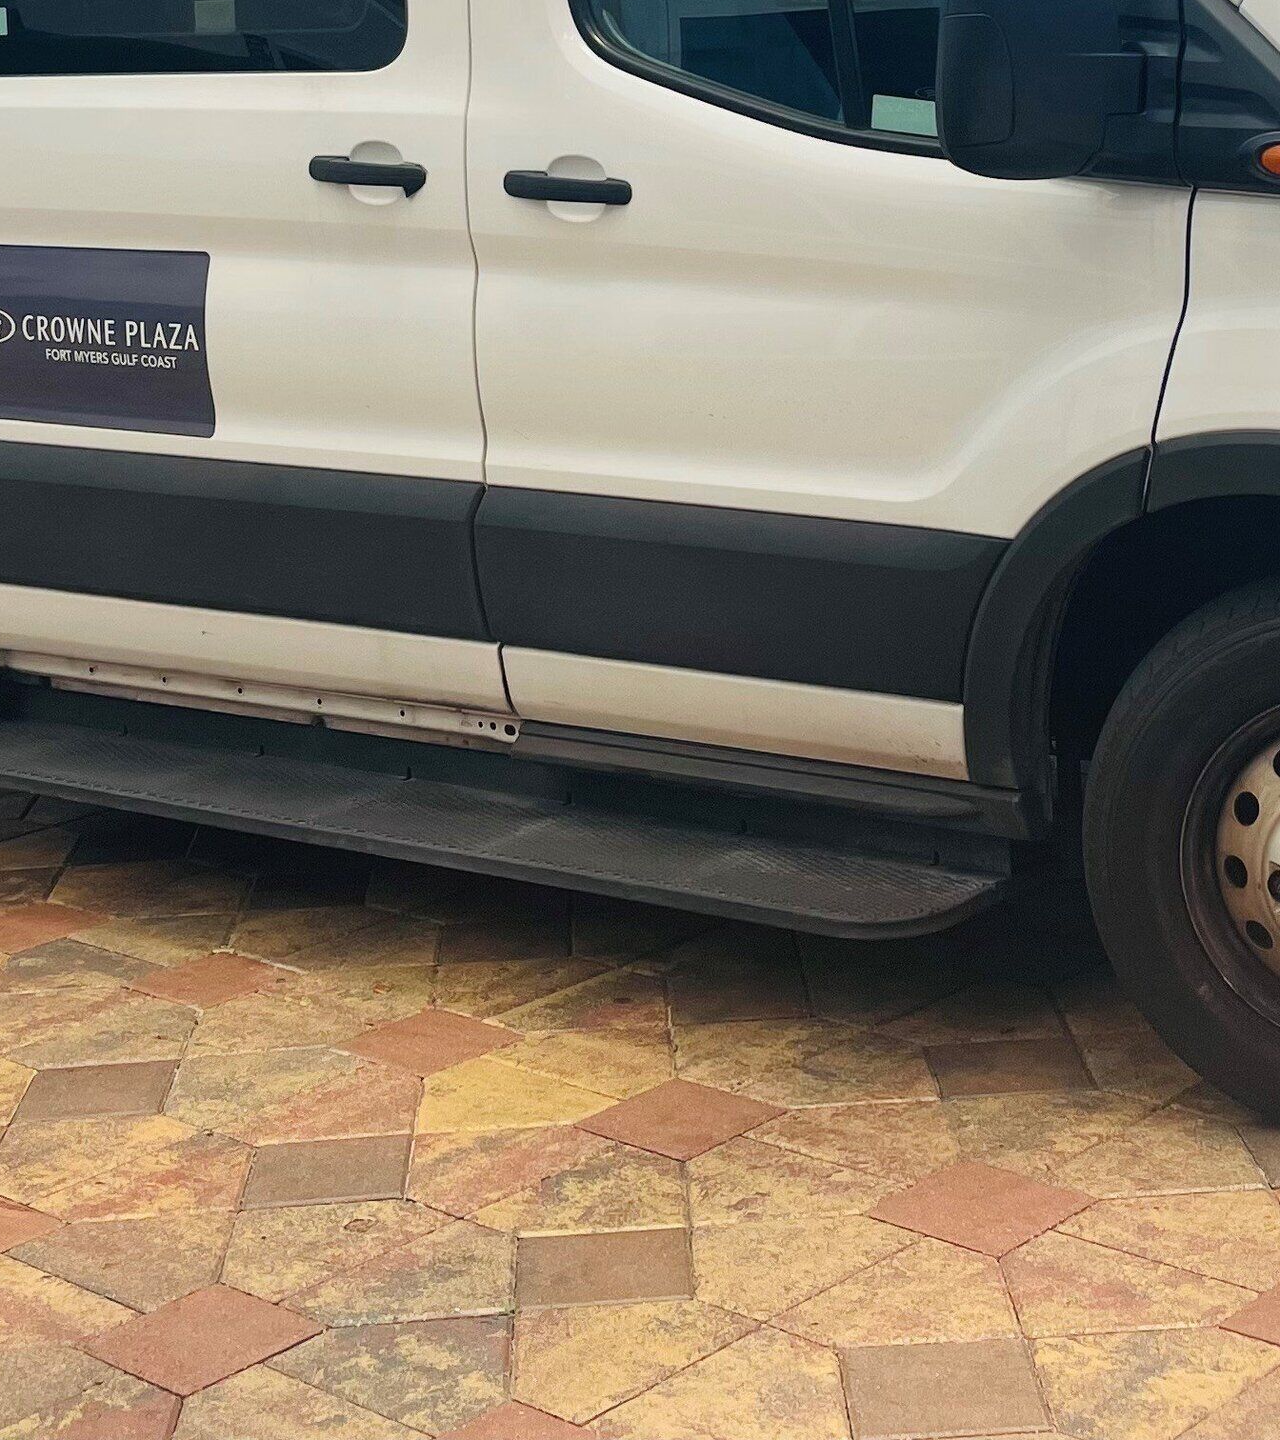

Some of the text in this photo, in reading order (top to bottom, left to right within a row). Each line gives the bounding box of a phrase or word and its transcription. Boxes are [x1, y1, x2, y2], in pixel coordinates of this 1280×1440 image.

[21, 314, 200, 352] CROWNE PLAZA
[45, 348, 178, 369] FORT MYERS GULF COAST
